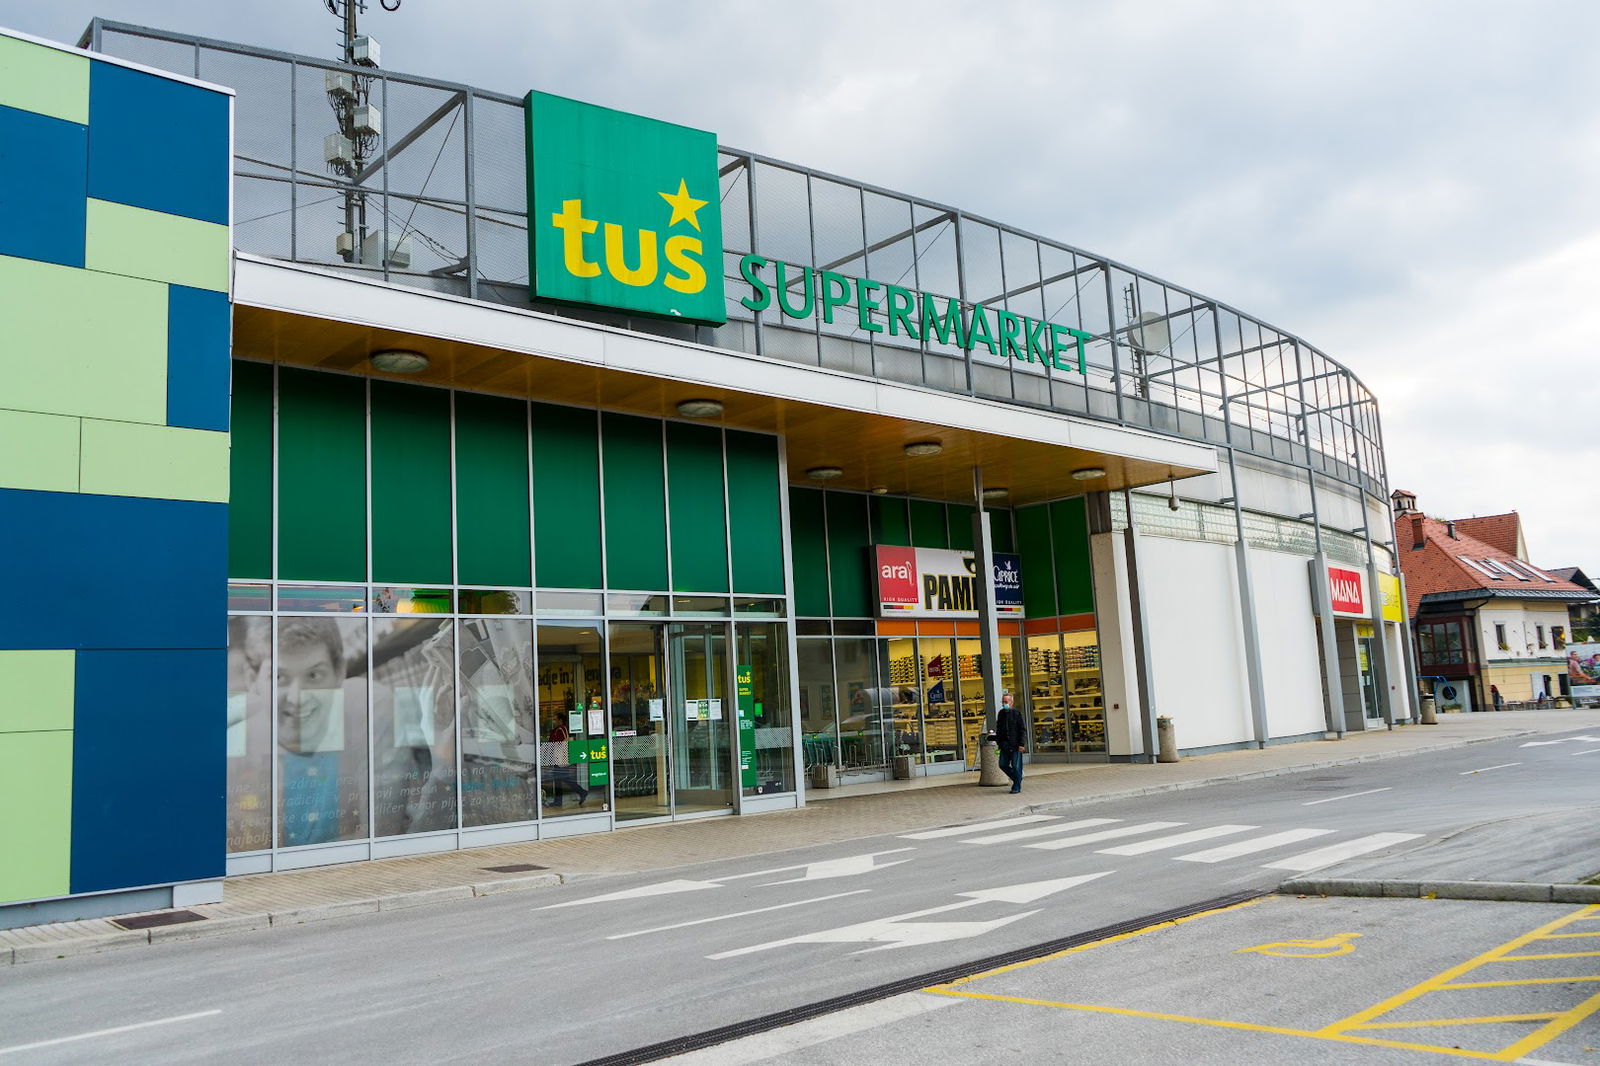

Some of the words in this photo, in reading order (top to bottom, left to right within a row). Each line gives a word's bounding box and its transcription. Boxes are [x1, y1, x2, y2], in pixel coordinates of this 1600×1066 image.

[740, 253, 1092, 375] SUPERMARKET
[881, 565, 908, 580] ara
[1330, 577, 1360, 604] MANA
